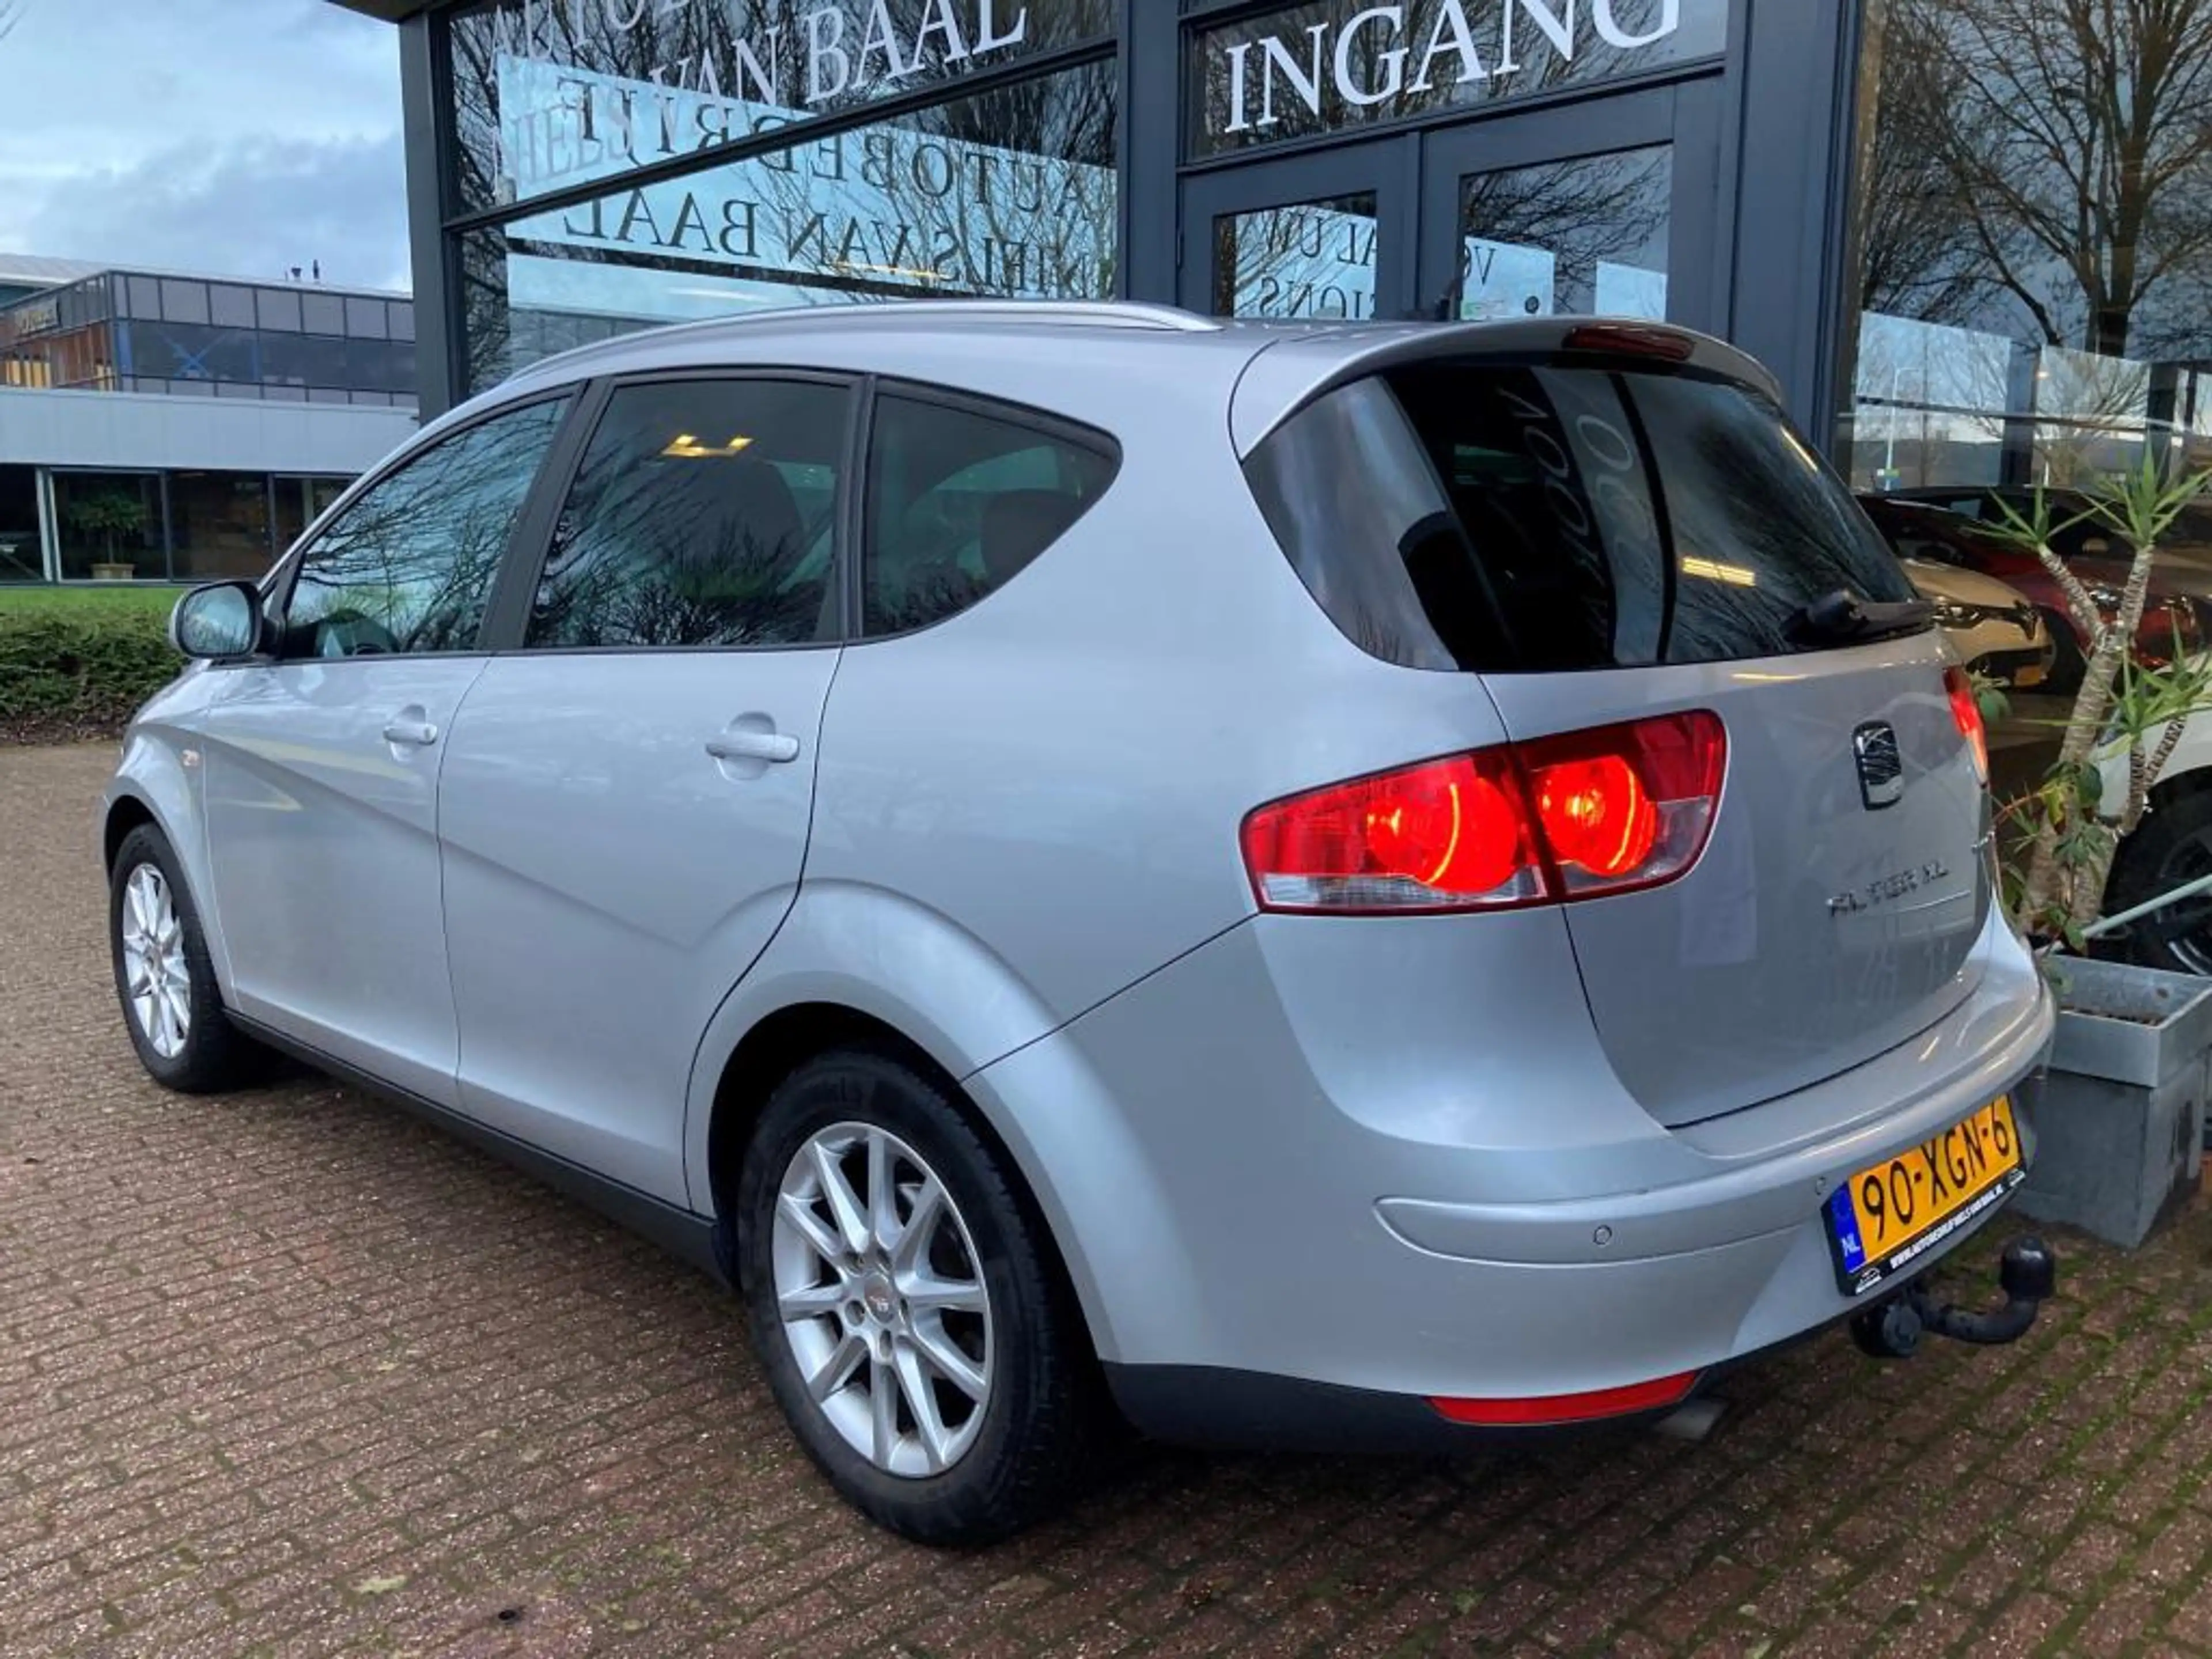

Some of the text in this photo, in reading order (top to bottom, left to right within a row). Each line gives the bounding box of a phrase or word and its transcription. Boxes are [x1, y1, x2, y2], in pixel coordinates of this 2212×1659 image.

[649, 26, 779, 154] VAN
[805, 0, 1027, 105] BAAL
[1862, 1101, 2010, 1241] 90-XGN-6
[1842, 1232, 1861, 1258] NL
